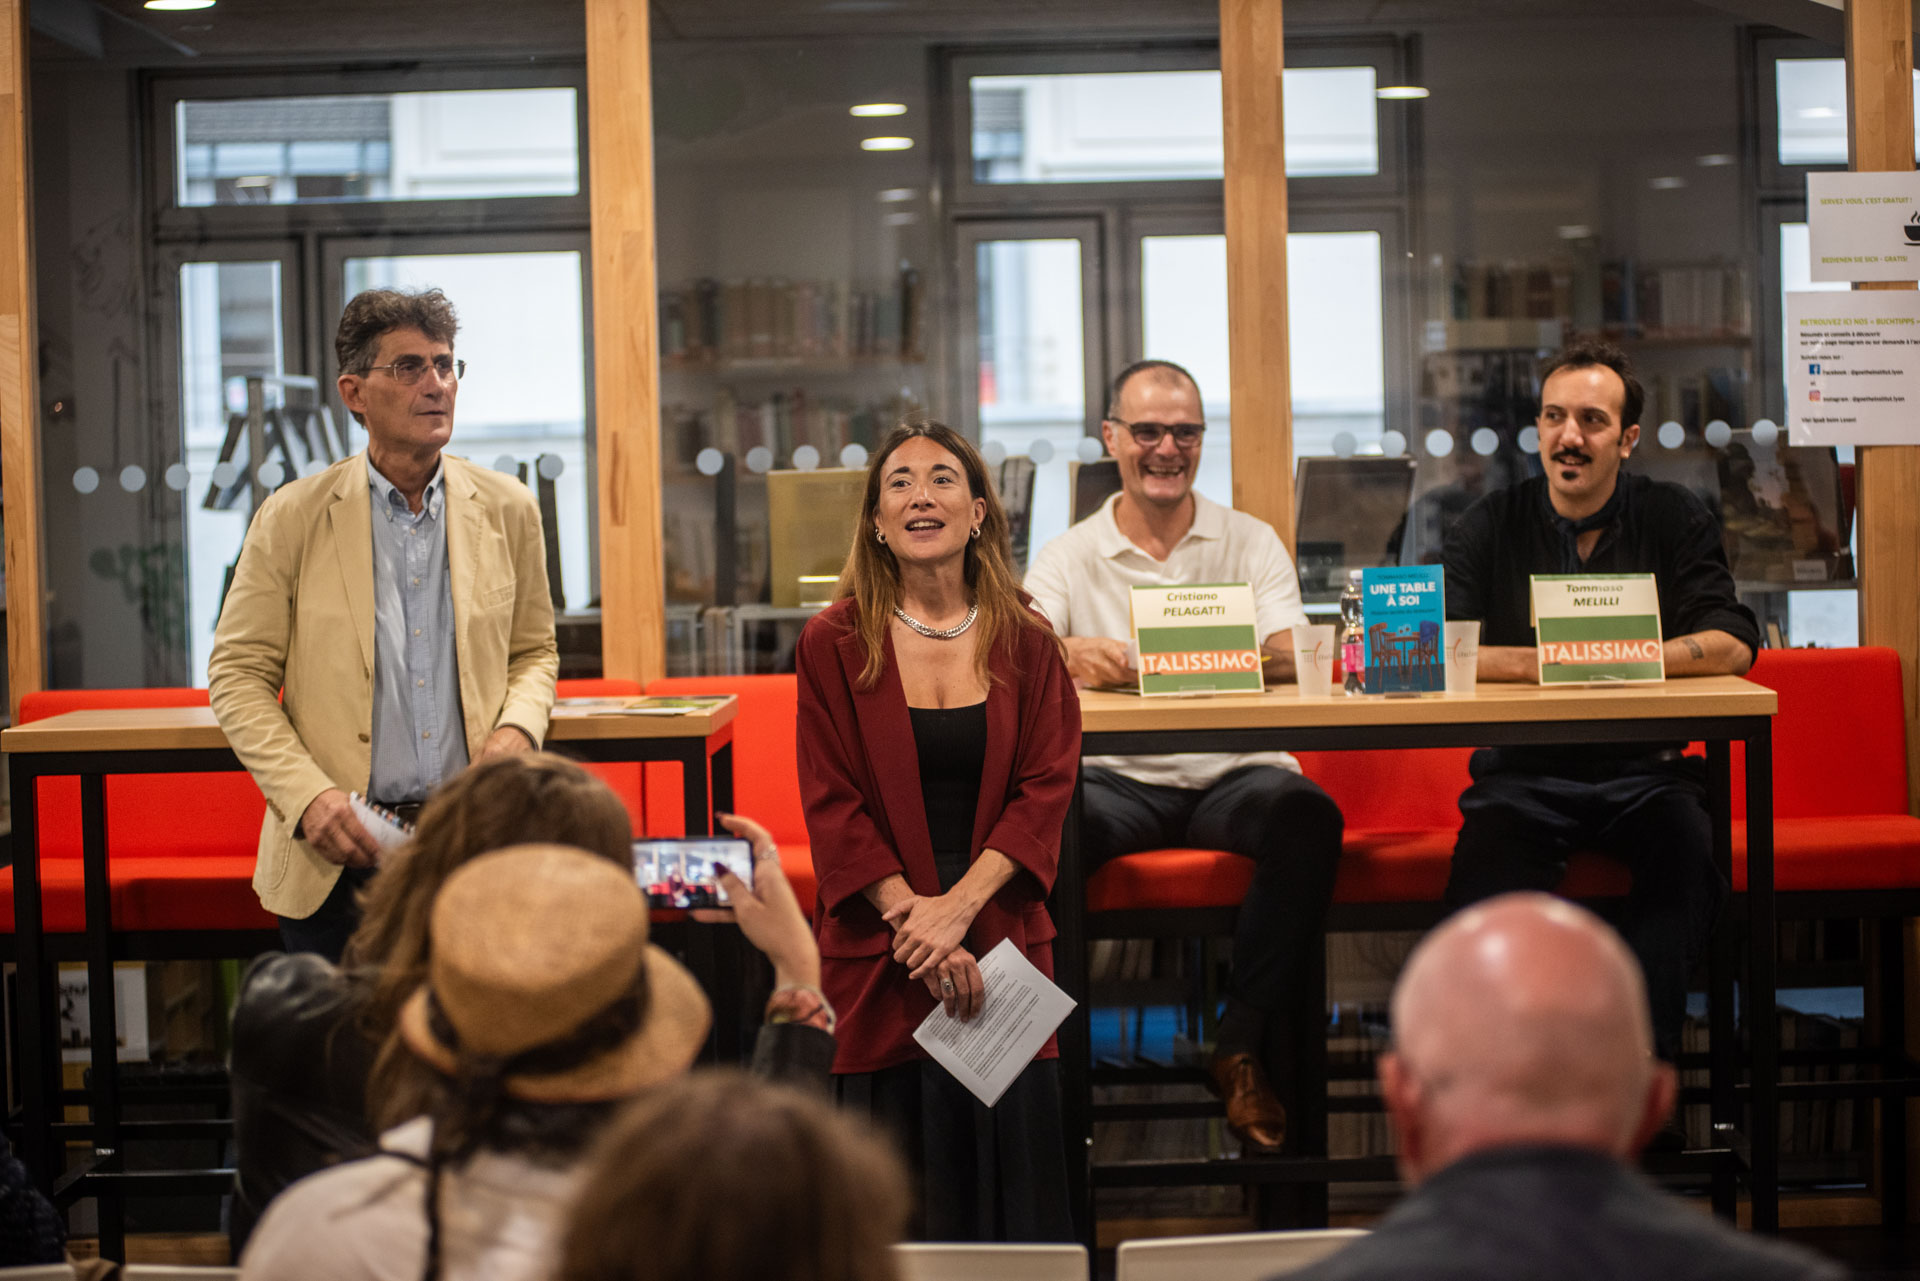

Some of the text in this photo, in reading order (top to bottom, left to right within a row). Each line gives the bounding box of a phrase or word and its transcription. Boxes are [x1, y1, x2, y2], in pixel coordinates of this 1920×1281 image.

[1882, 196, 1908, 204] GRATUIT
[1800, 318, 1841, 326] RETROUVEZ
[1843, 318, 1852, 326] ICI
[1876, 317, 1915, 325] BUCHTIPPS
[1369, 581, 1436, 595] UNE TABLE
[1565, 583, 1624, 593] Tommaso
[1166, 591, 1218, 601] Cristiano
[1386, 594, 1420, 607] À SOI
[1573, 596, 1620, 607] MELILLI
[1163, 605, 1225, 617] PELAGATTI
[1541, 641, 1659, 662] ITALISSIMO
[1140, 651, 1258, 673] ITALISSIMO
